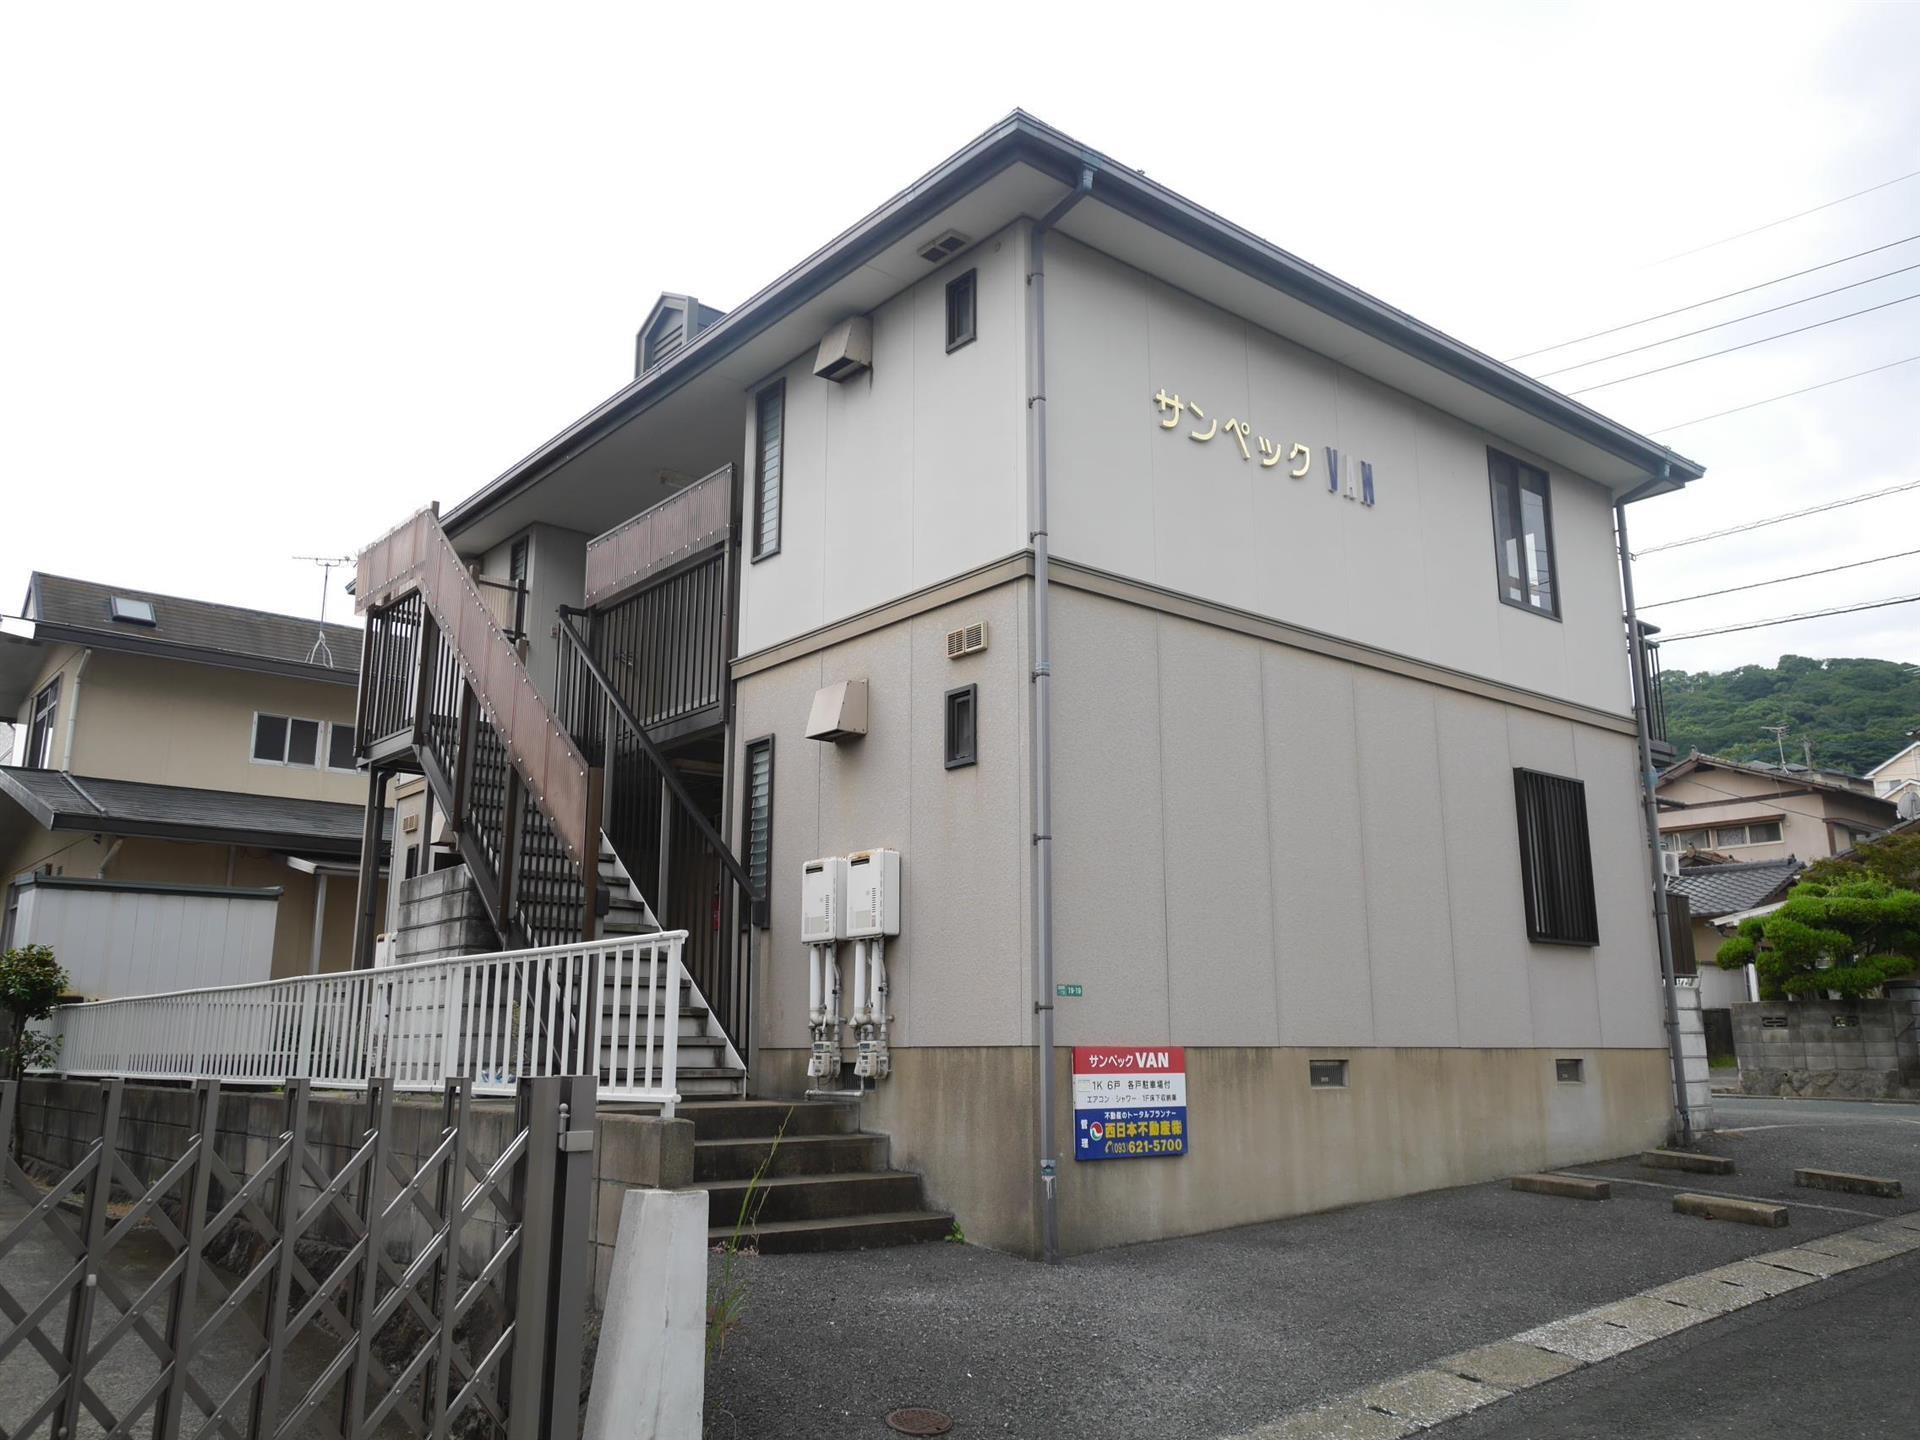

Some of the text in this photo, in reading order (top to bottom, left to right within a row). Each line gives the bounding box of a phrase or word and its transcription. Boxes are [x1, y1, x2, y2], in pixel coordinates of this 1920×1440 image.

[1154, 388, 1310, 479] サンペック
[1135, 1052, 1169, 1068] VAN
[1092, 1080, 1103, 1090] 1K
[1107, 1080, 1121, 1090] 6戸
